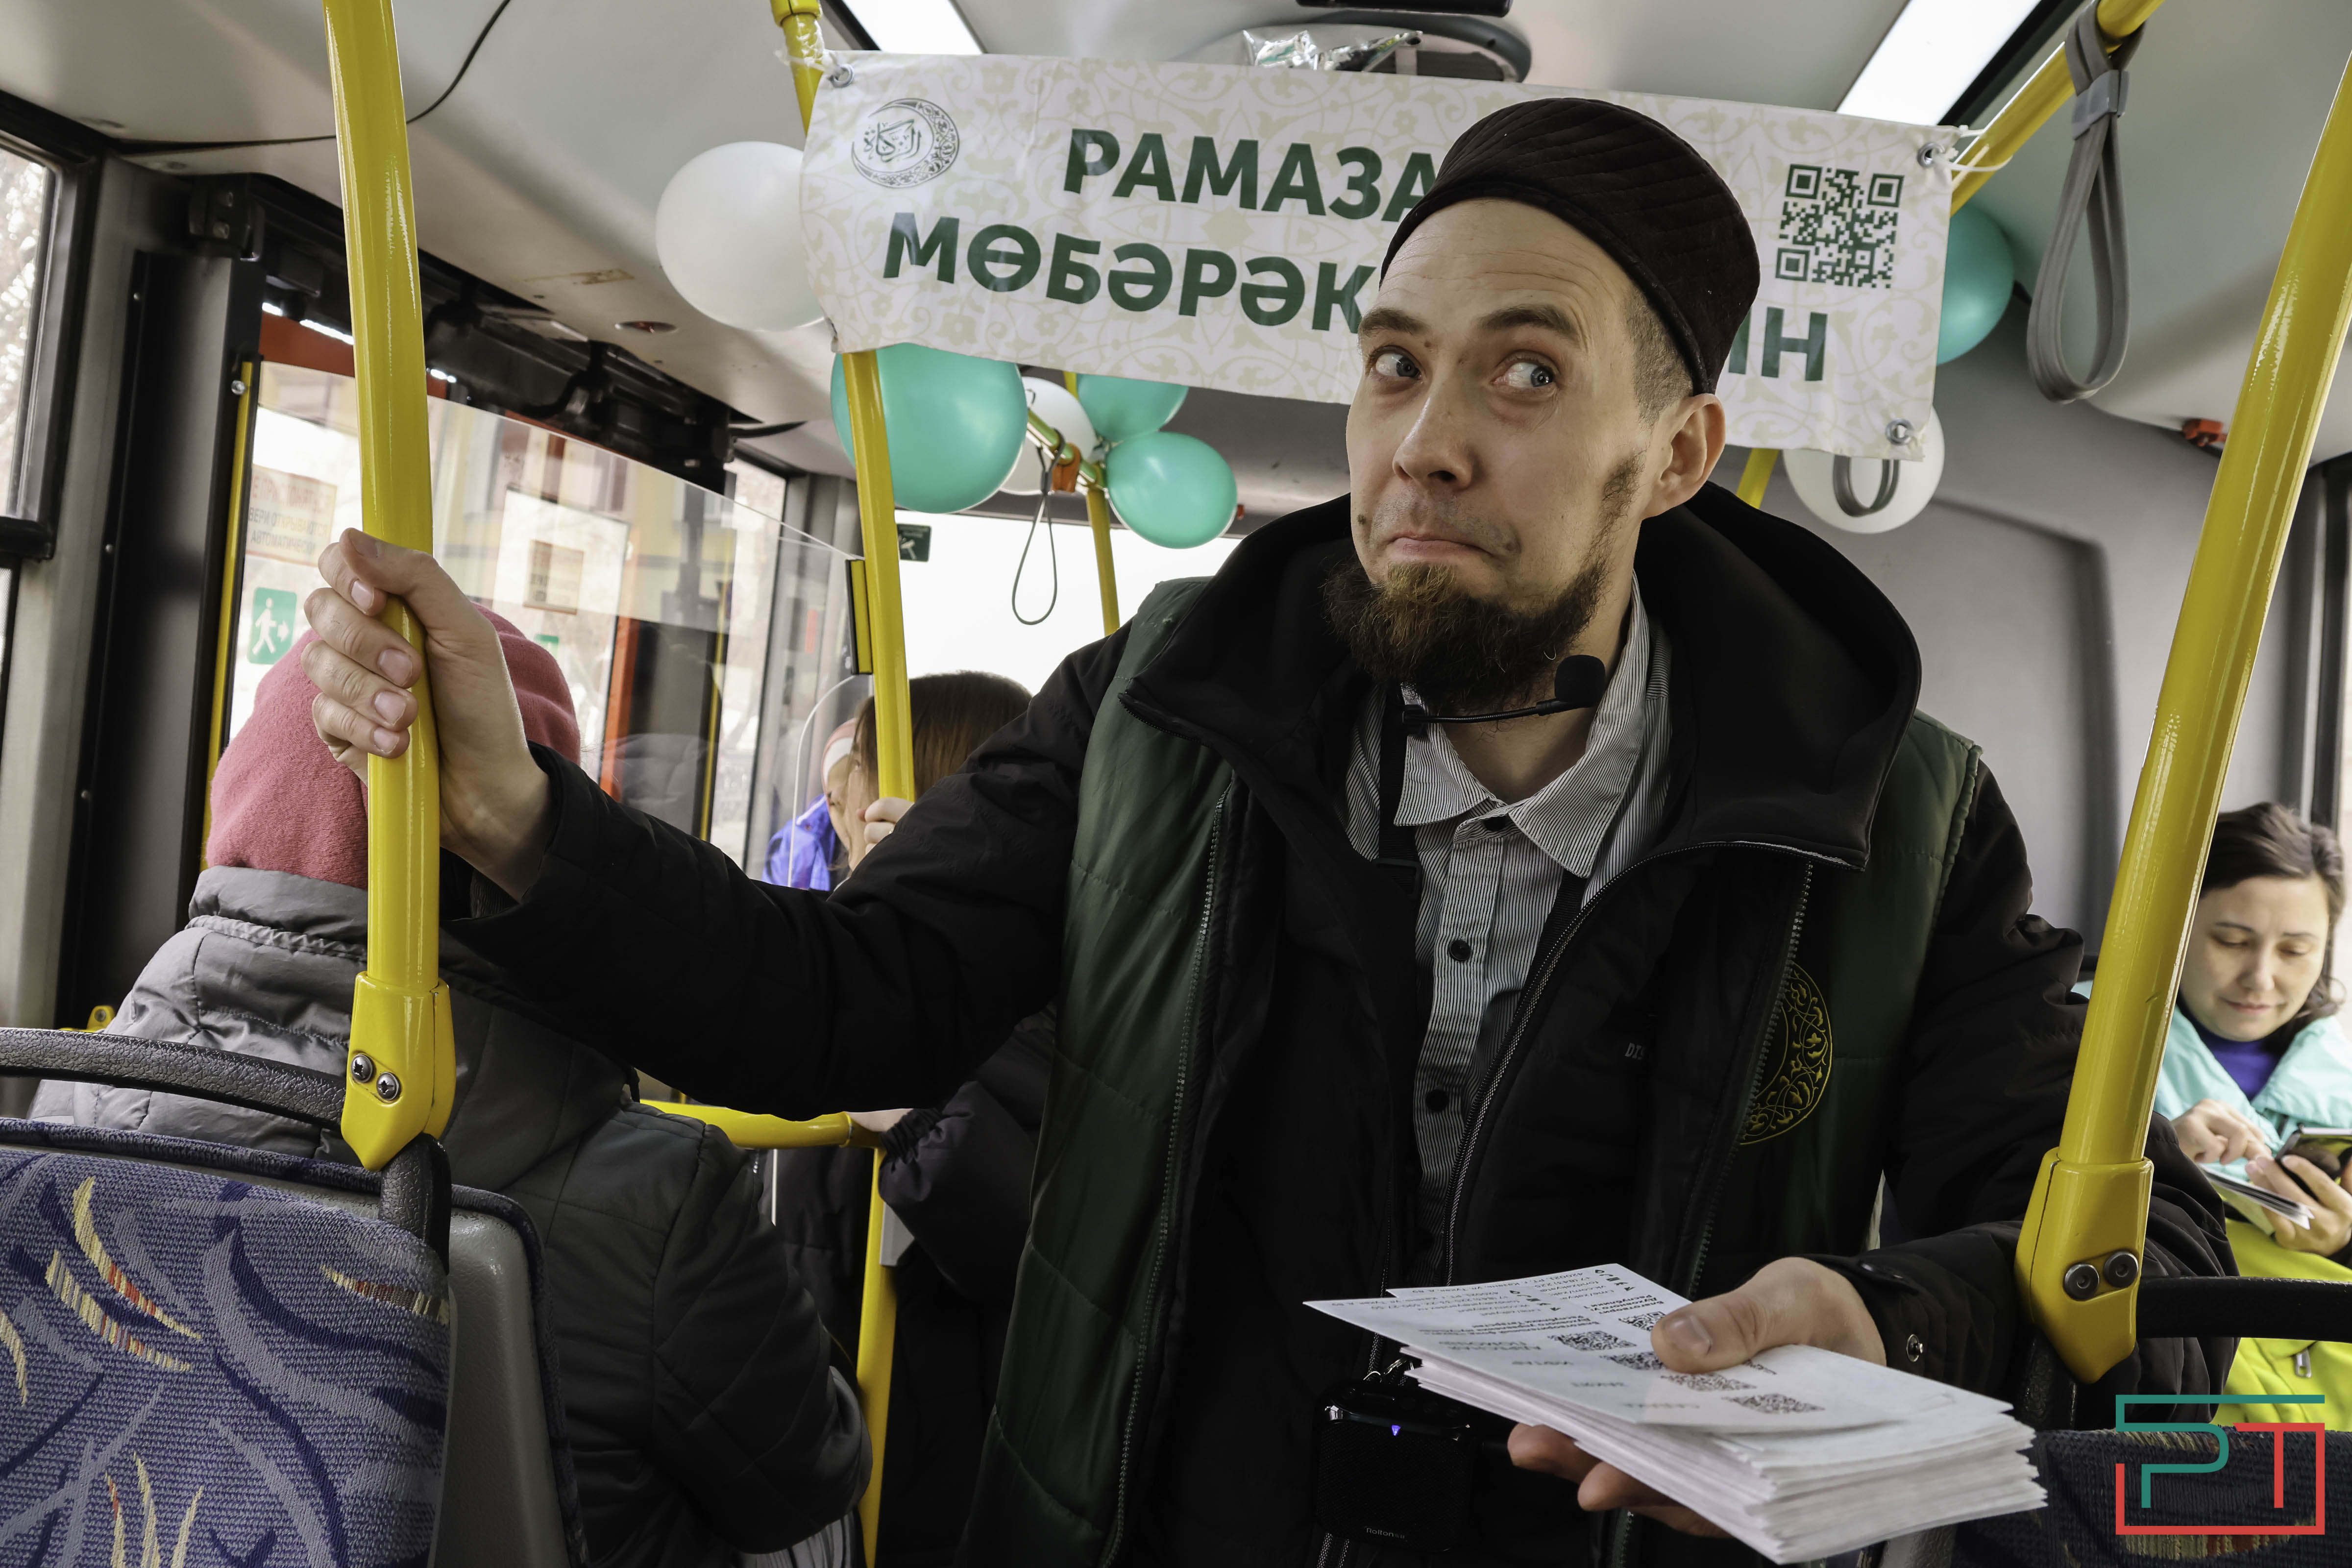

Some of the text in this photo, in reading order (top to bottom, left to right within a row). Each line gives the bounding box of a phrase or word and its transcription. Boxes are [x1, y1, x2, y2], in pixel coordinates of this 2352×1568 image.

[1064, 128, 1436, 222] РАМАЗА
[883, 212, 1376, 334] МӨБӘРӘК
[248, 507, 270, 525] ВЕРИ
[1366, 1527, 1394, 1537] Rolton
